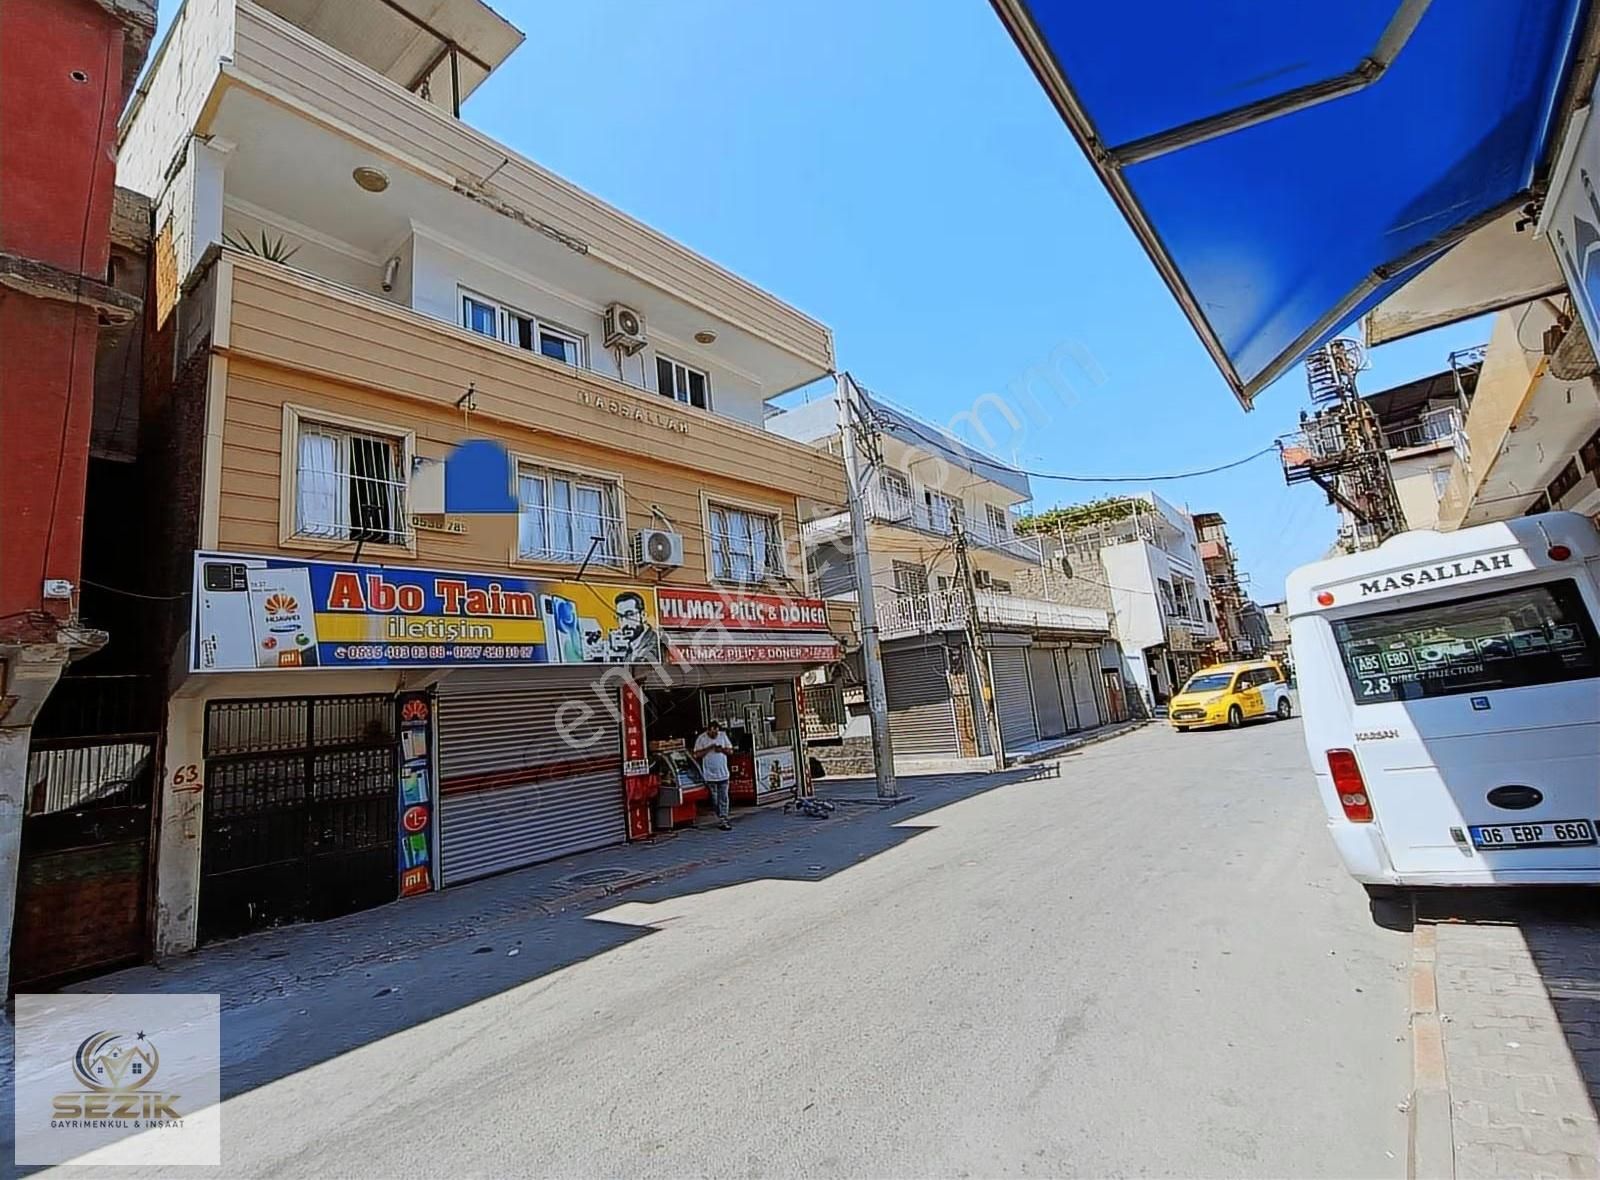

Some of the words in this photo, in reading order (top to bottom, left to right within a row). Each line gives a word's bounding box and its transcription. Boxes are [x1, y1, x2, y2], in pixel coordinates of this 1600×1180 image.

[328, 572, 424, 613] Abo
[434, 579, 537, 618] Taim
[659, 598, 725, 620] YILMAZ
[768, 606, 778, 621] &
[387, 616, 493, 641] iletişim
[1359, 655, 1380, 672] ABS
[1386, 651, 1409, 667] EBD
[1362, 677, 1391, 696] 2.8
[172, 764, 199, 785] 63
[1481, 828, 1504, 843] 06
[1511, 825, 1544, 842] EBP
[1553, 823, 1590, 841] 660
